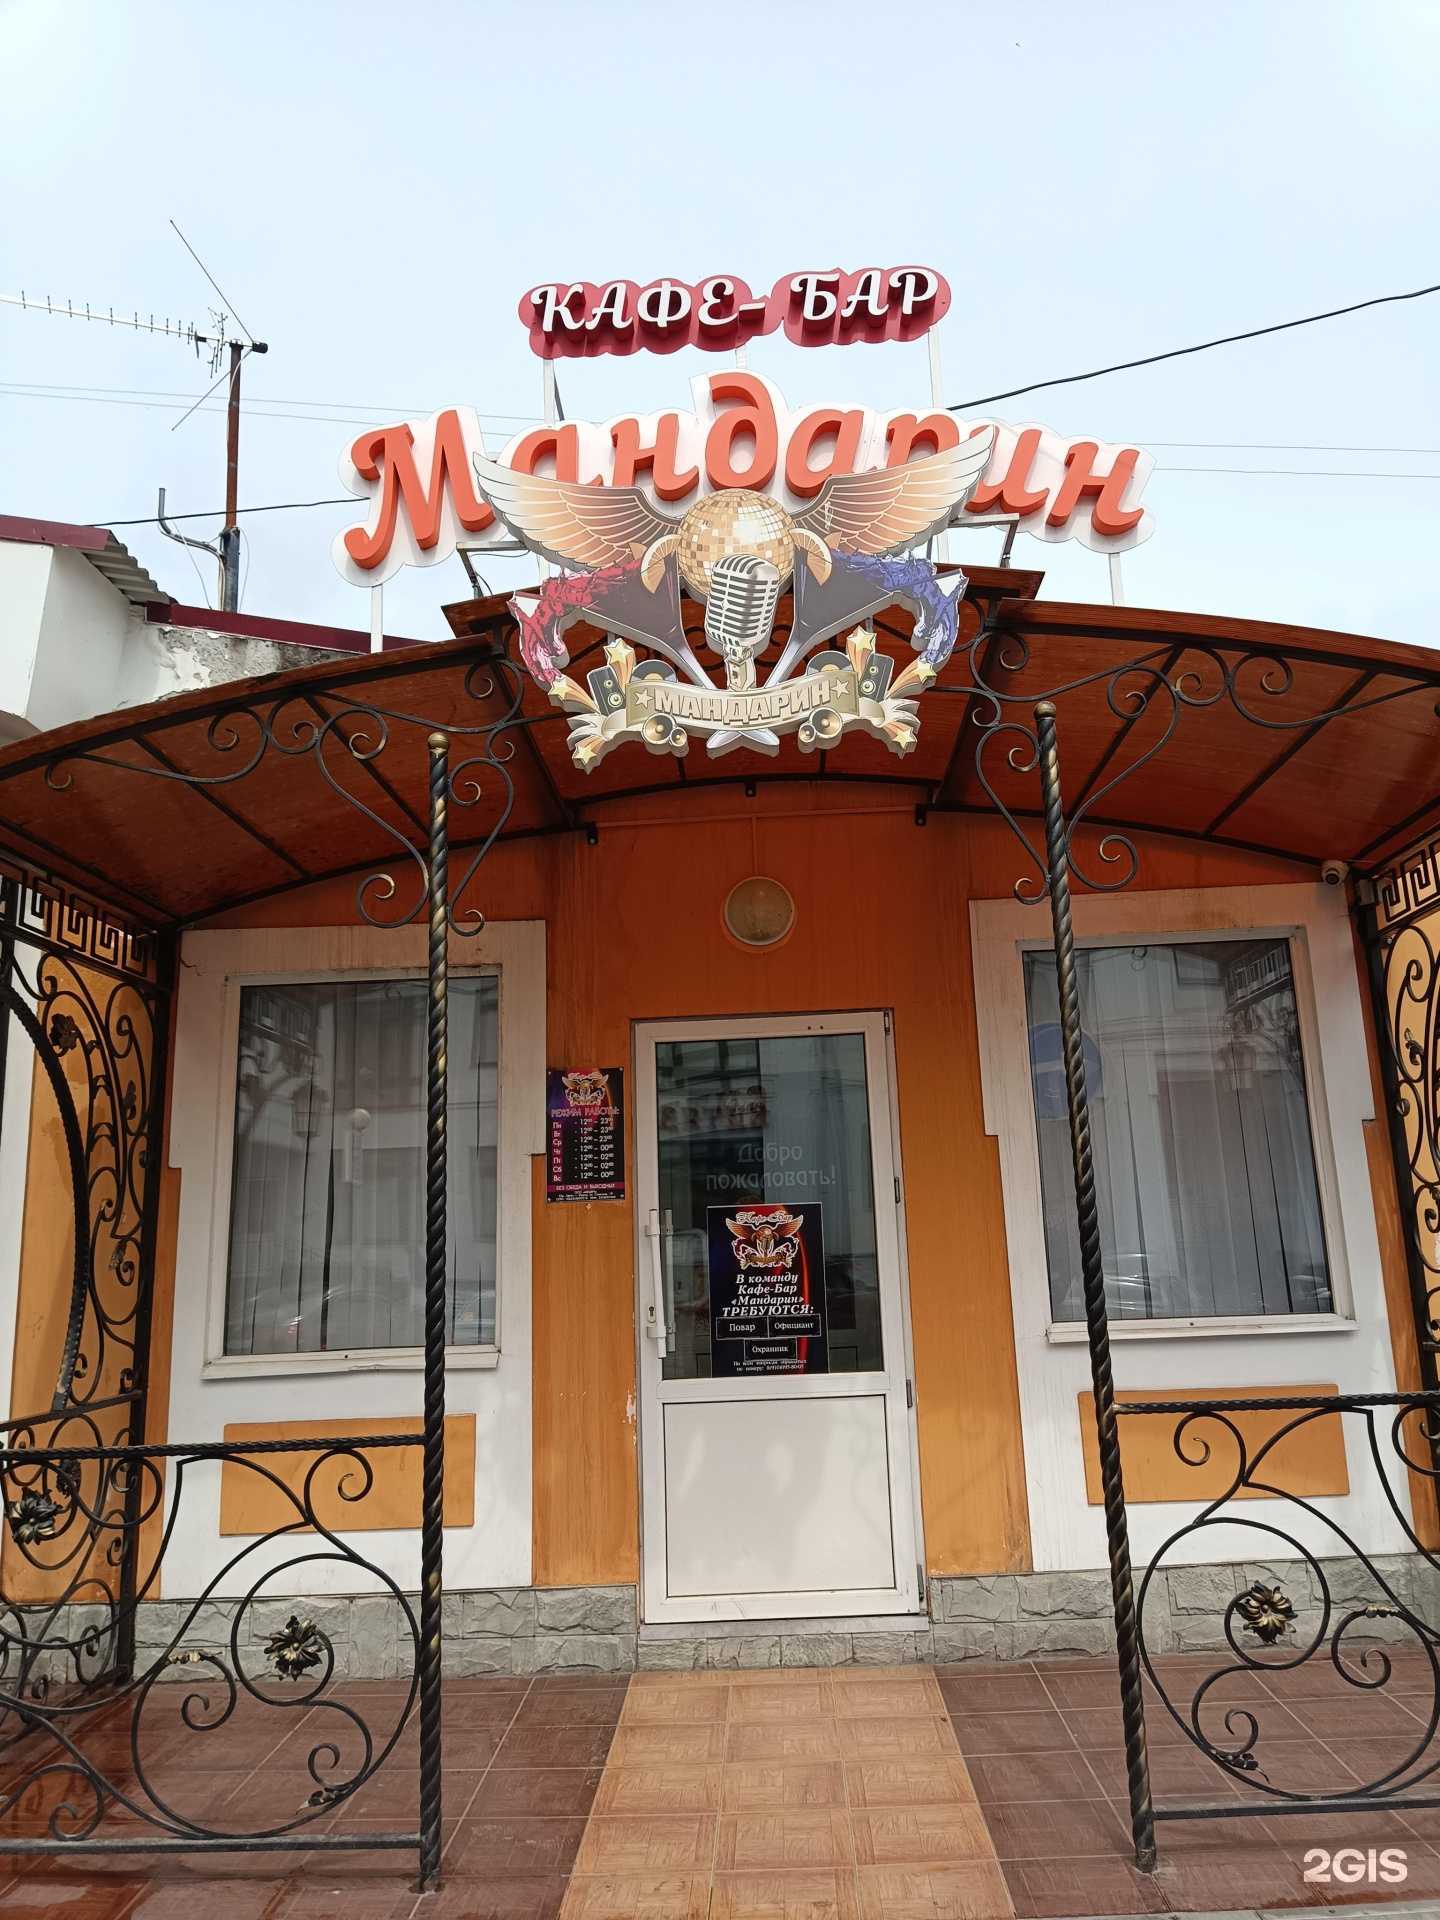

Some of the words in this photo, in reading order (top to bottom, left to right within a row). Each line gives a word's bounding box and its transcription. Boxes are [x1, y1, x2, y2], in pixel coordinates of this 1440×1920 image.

[654, 679, 831, 726] МАНДАРИН
[738, 1142, 802, 1166] Добро
[706, 1164, 836, 1191] пожаловать!
[736, 1274, 745, 1284] В
[748, 1272, 799, 1283] команду
[737, 1284, 797, 1295] Кафе-Бар
[722, 1304, 814, 1317] ТРЕБУЮТСЯ:
[729, 1323, 756, 1332] Повар
[774, 1322, 814, 1330] Официант
[752, 1345, 788, 1355] Охранник
